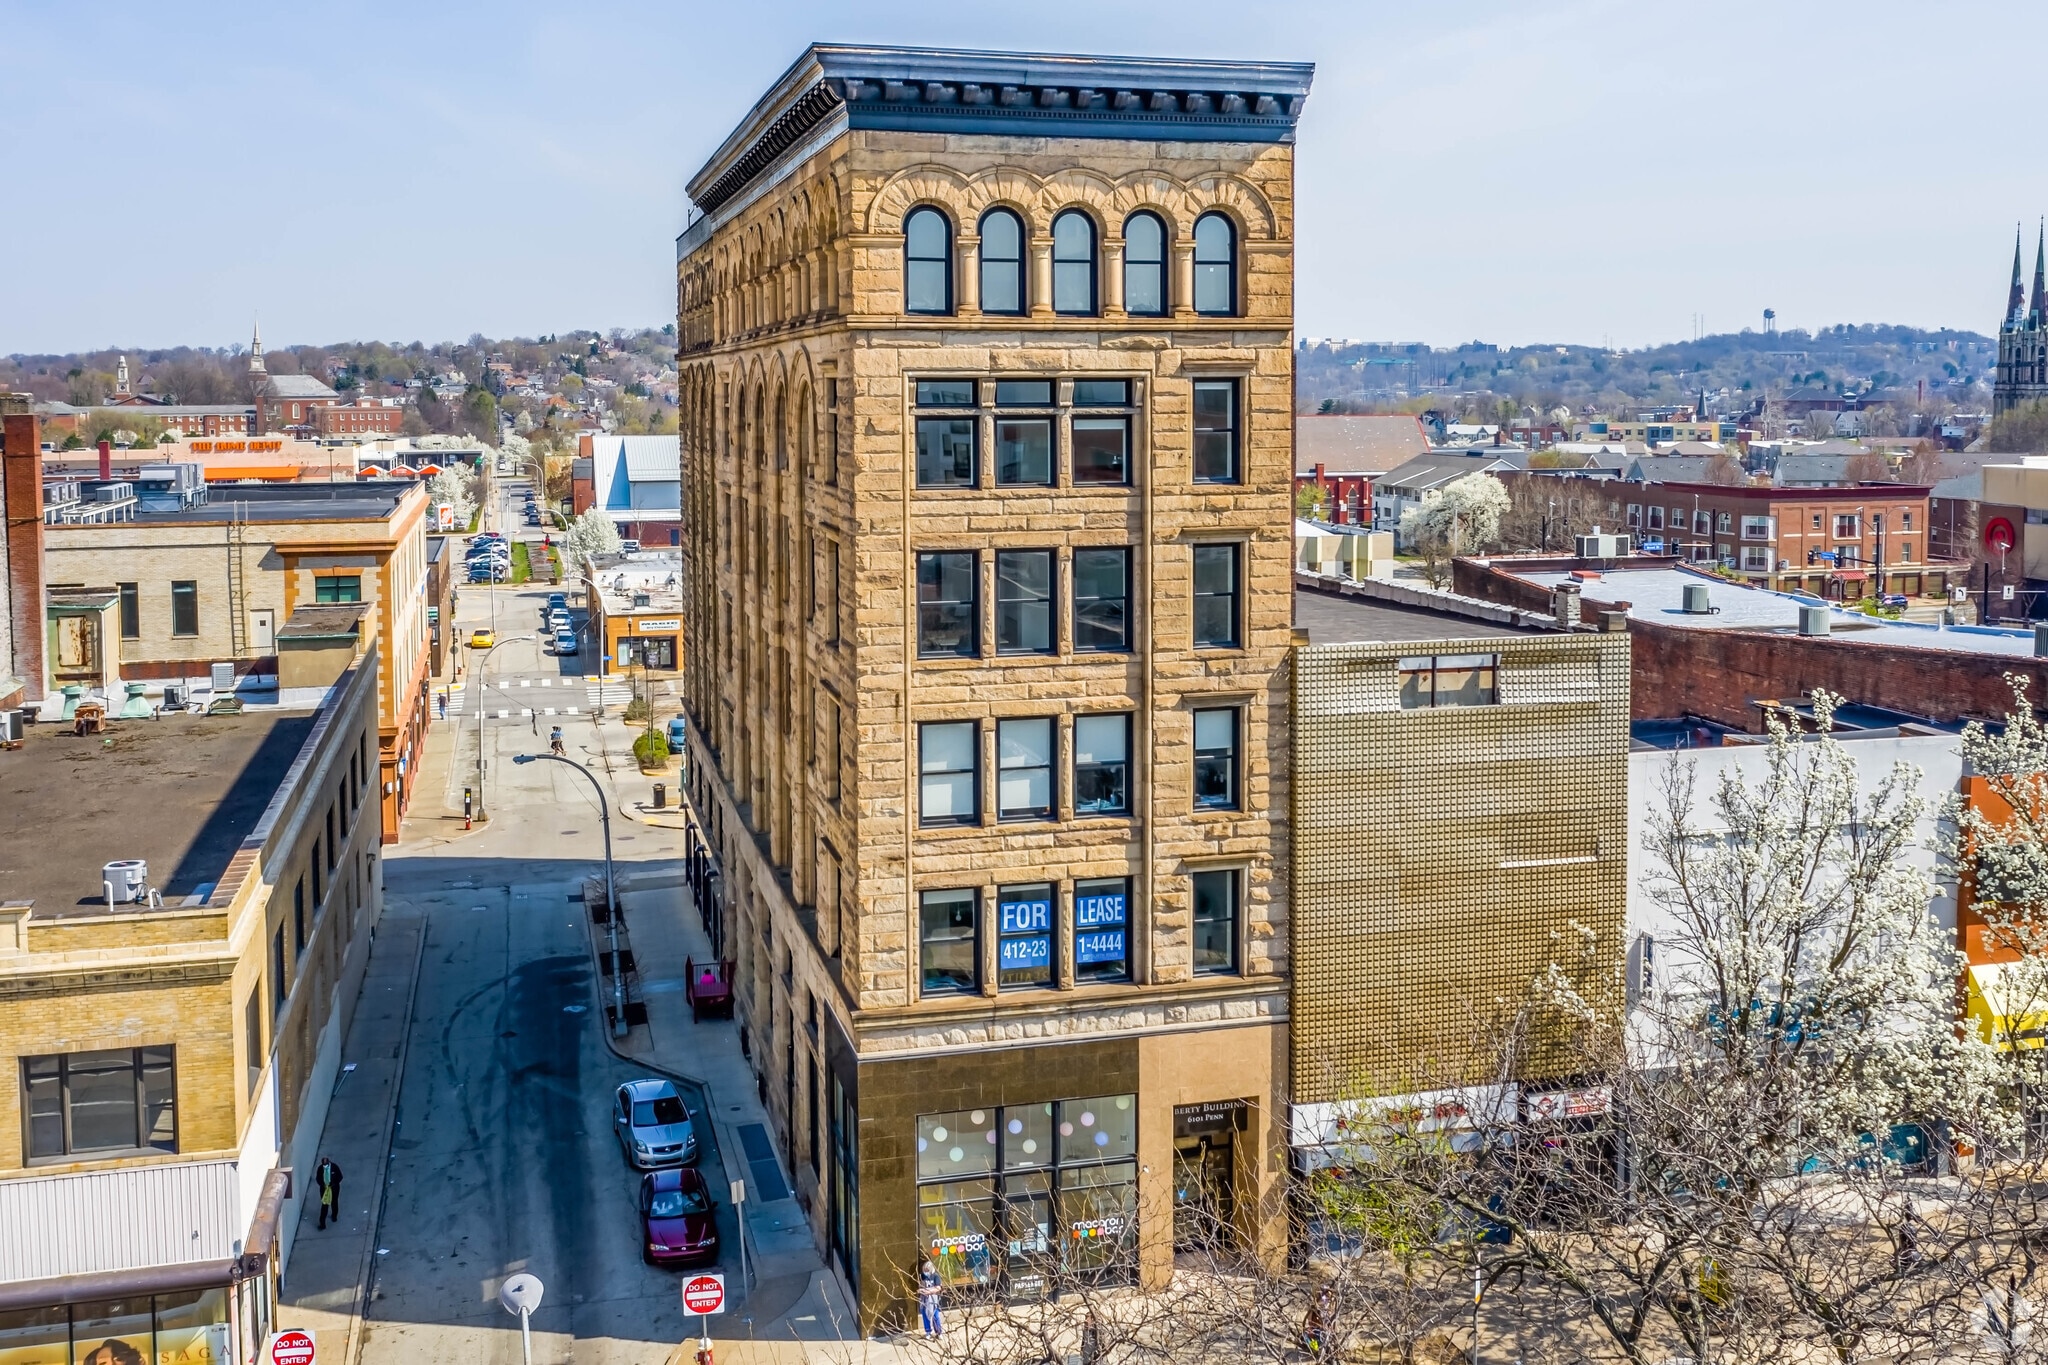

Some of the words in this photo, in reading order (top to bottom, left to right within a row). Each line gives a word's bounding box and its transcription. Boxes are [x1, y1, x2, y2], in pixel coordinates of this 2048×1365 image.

[1003, 903, 1047, 930] FOR
[1079, 897, 1123, 924] LEASE
[1003, 940, 1047, 959] 412-23
[1079, 934, 1122, 953] 1-4444
[1203, 1101, 1246, 1112] BUILDING
[1205, 1113, 1224, 1121] PENN
[1072, 1217, 1124, 1231] macaron
[931, 1233, 986, 1247] macaron
[965, 1240, 985, 1252] bar
[691, 1299, 717, 1308] ENTER
[277, 1340, 290, 1348] DO
[292, 1339, 309, 1347] NOT
[280, 1356, 307, 1365] ENTER
